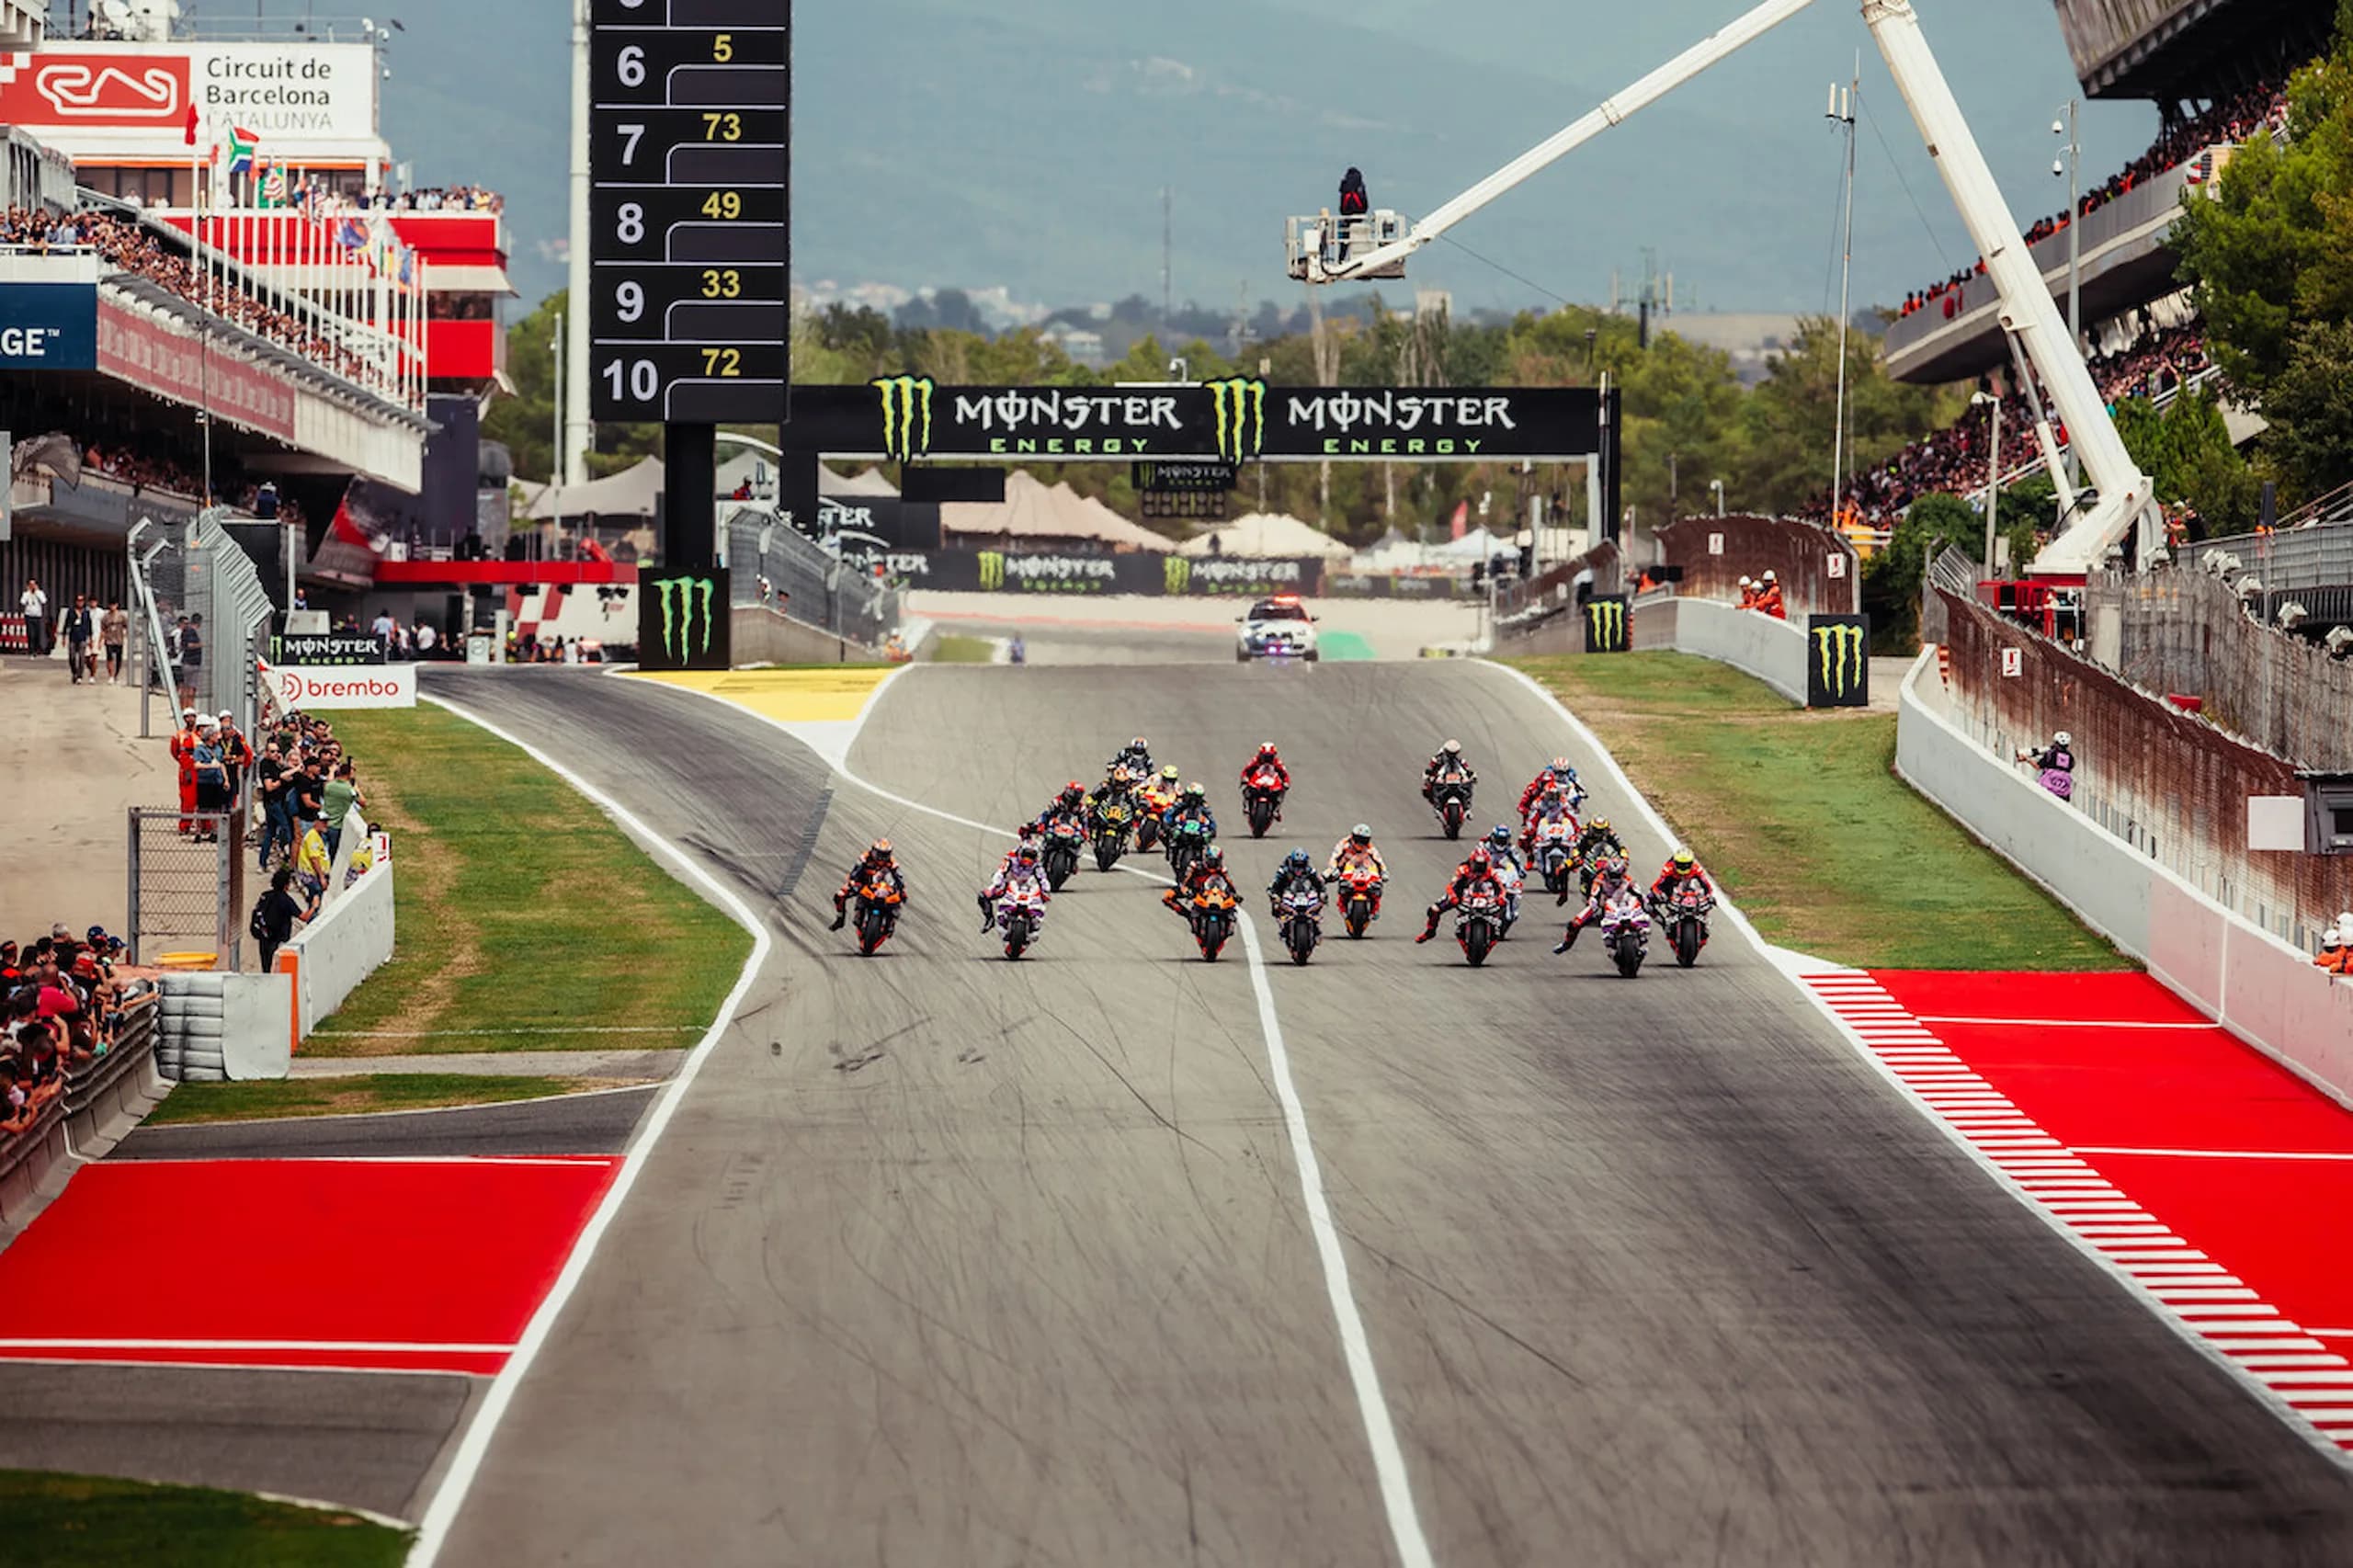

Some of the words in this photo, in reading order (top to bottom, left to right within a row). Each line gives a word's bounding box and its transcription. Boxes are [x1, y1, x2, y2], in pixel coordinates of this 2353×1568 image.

[713, 35, 733, 62] 5
[207, 56, 294, 79] Circuit
[301, 58, 331, 79] de
[617, 46, 645, 87] 6
[207, 85, 330, 105] Barcelona
[702, 113, 742, 142] 73
[617, 125, 645, 165] 7
[701, 191, 742, 220] 49
[617, 202, 644, 244] 8
[701, 270, 741, 299] 33
[616, 280, 644, 324] 9
[0, 327, 60, 356] GE™
[701, 348, 741, 377] 72
[602, 358, 658, 402] 10
[955, 390, 1182, 432] MONSTER
[1288, 391, 1516, 432] MONSTER
[990, 437, 1149, 454] ENERGY
[1324, 438, 1483, 454] ENERGY
[285, 637, 379, 655] MONSTER
[308, 678, 399, 697] brembo
